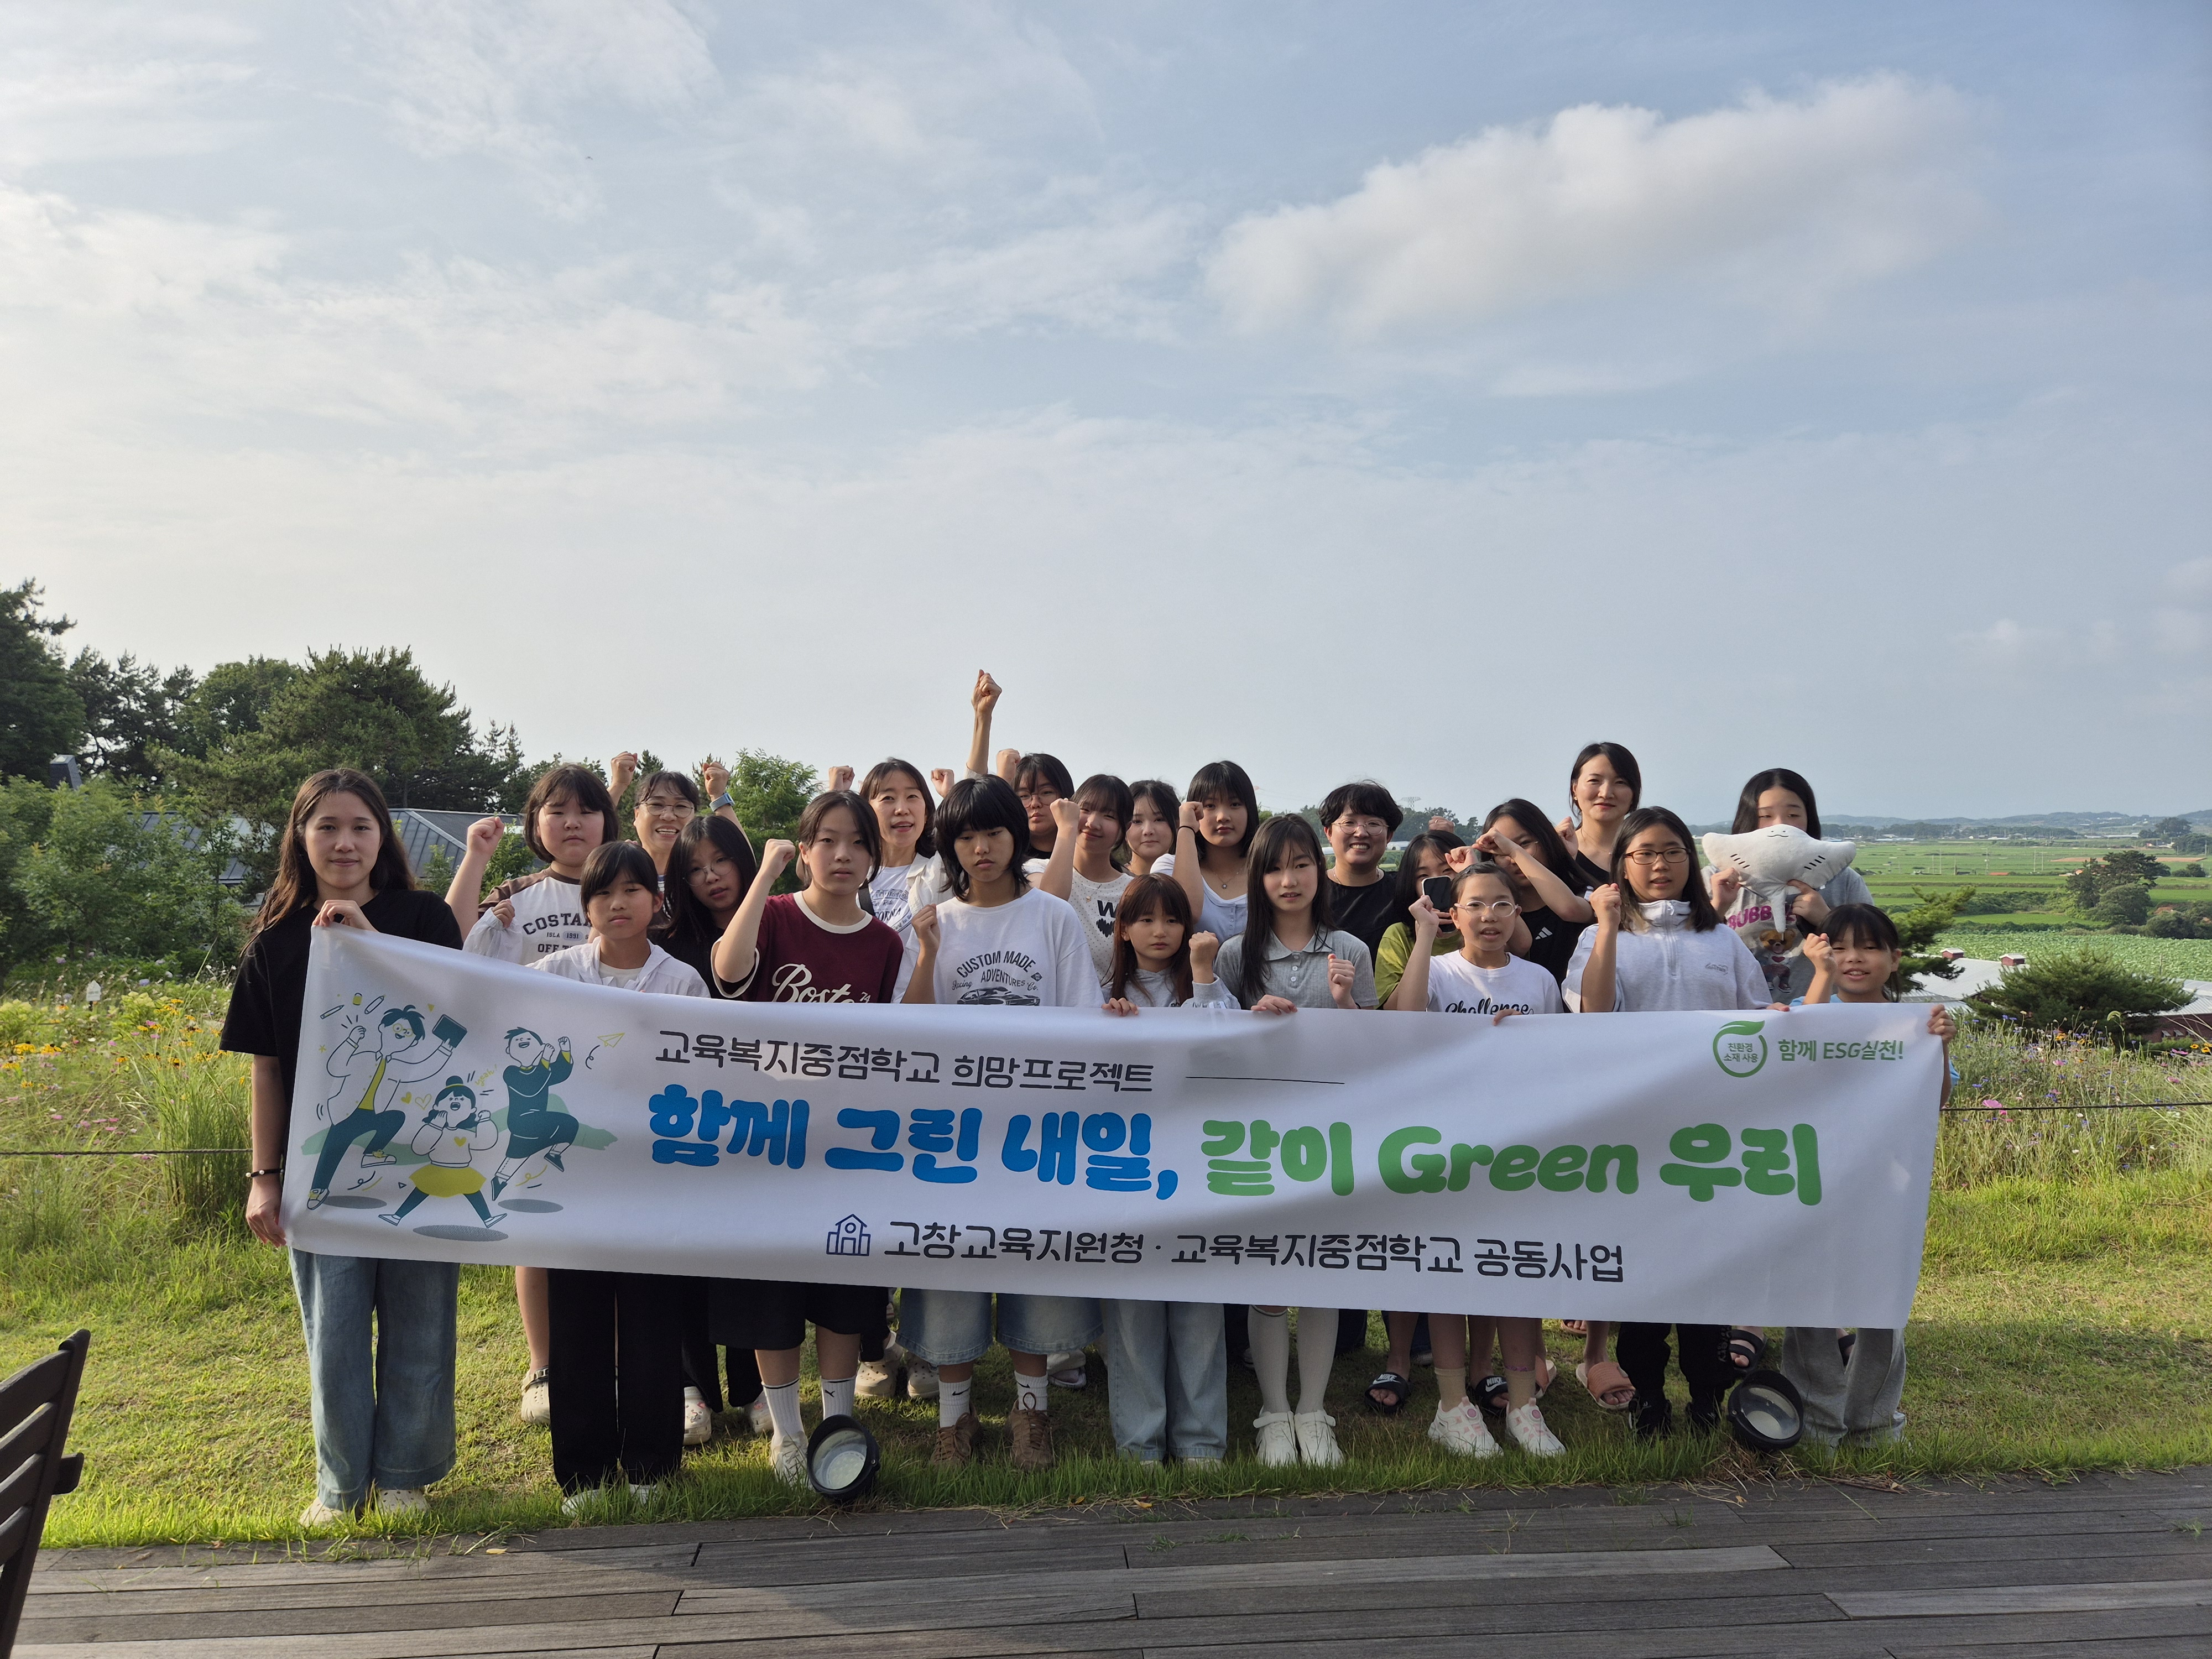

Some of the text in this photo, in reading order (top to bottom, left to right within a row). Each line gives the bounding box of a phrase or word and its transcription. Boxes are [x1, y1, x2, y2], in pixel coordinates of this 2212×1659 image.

[956, 951, 1036, 978] CUSTOM MADE
[771, 963, 855, 1003] Bost
[952, 979, 973, 990] Racing
[980, 968, 1026, 987] ADVENTURES
[1723, 1052, 1759, 1063] 소재 사용
[1728, 1042, 1753, 1053] 친환경
[1778, 1039, 1903, 1062] 함께 ESG실천!
[655, 1030, 1154, 1093] 교육복지중점학교 희망프로젝트
[648, 1084, 1822, 1206] 함께 그린 내일, 같이 Green 우리
[884, 1221, 1145, 1264] 고창교육지원청
[1171, 1234, 1464, 1275] 교육복지중점학교
[1474, 1239, 1625, 1284] 공동사업
[1378, 1373, 1397, 1381] NIKE
[1486, 1377, 1503, 1386] NIKE
